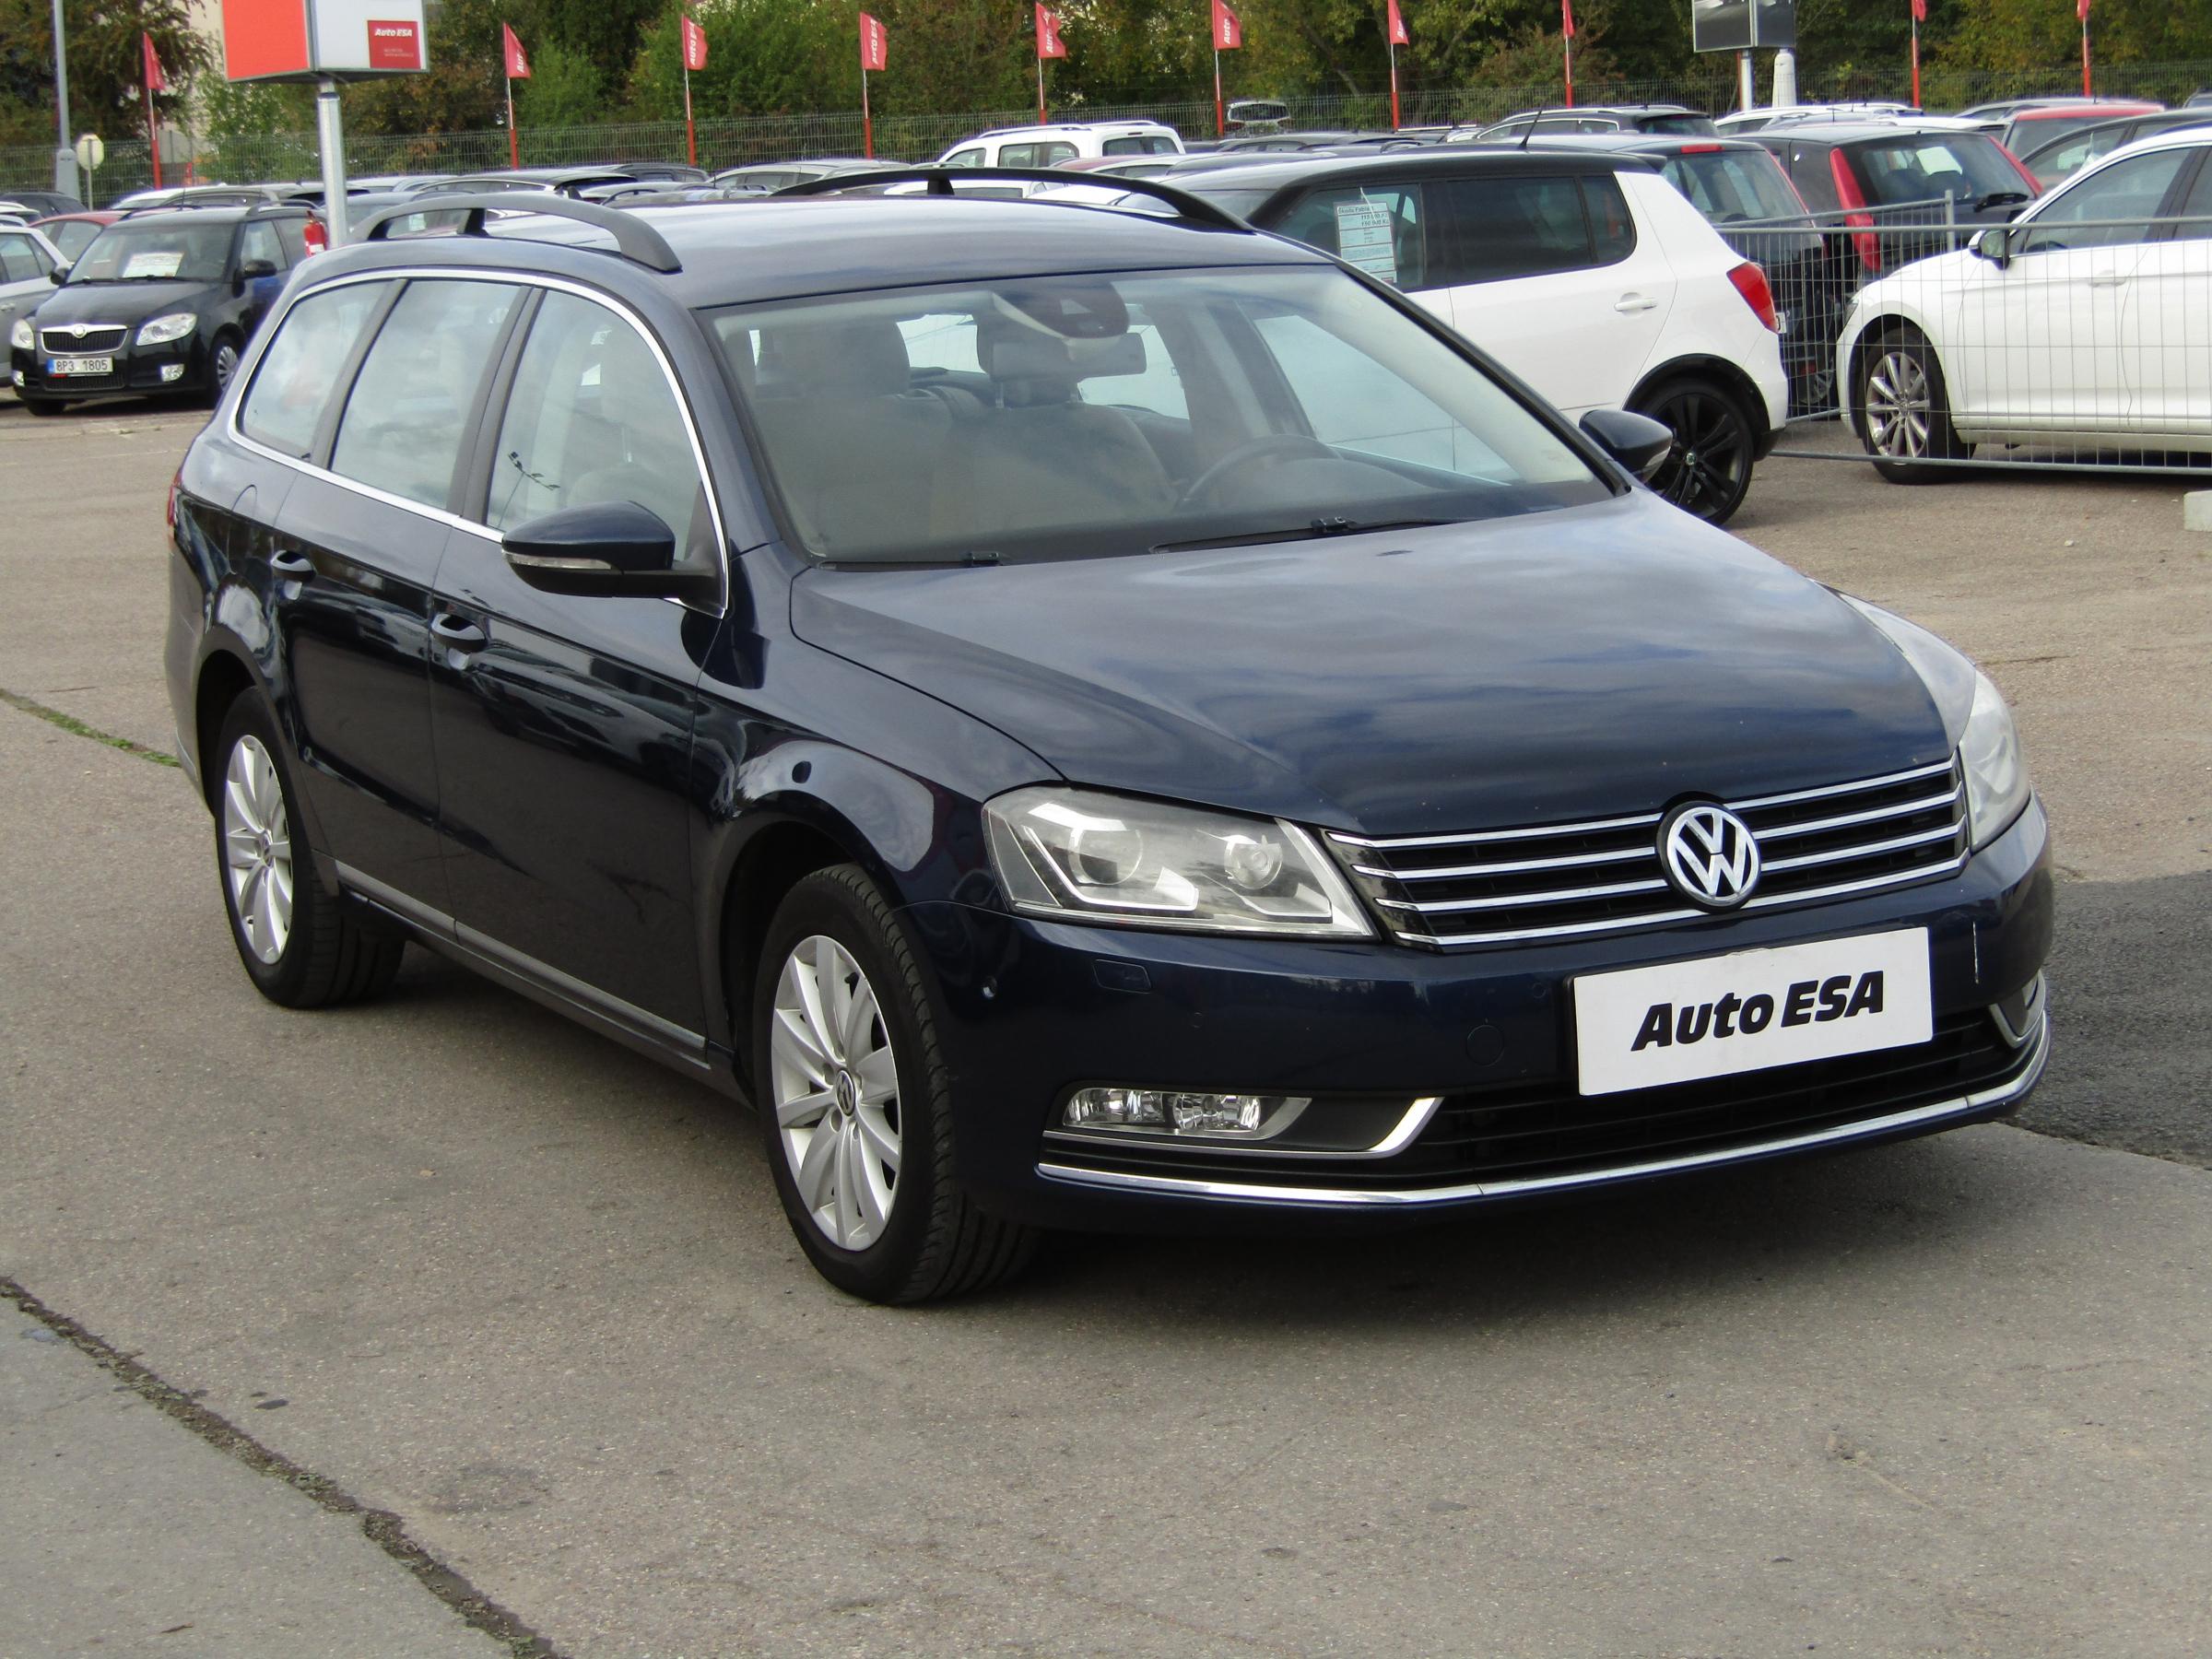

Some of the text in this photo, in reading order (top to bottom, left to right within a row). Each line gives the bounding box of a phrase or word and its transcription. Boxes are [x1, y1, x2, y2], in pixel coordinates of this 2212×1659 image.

[374, 29, 413, 37] Auto ESA
[82, 359, 108, 371] 1805
[1666, 806, 1759, 907] VW
[1630, 970, 1884, 1051] Auto ESA
